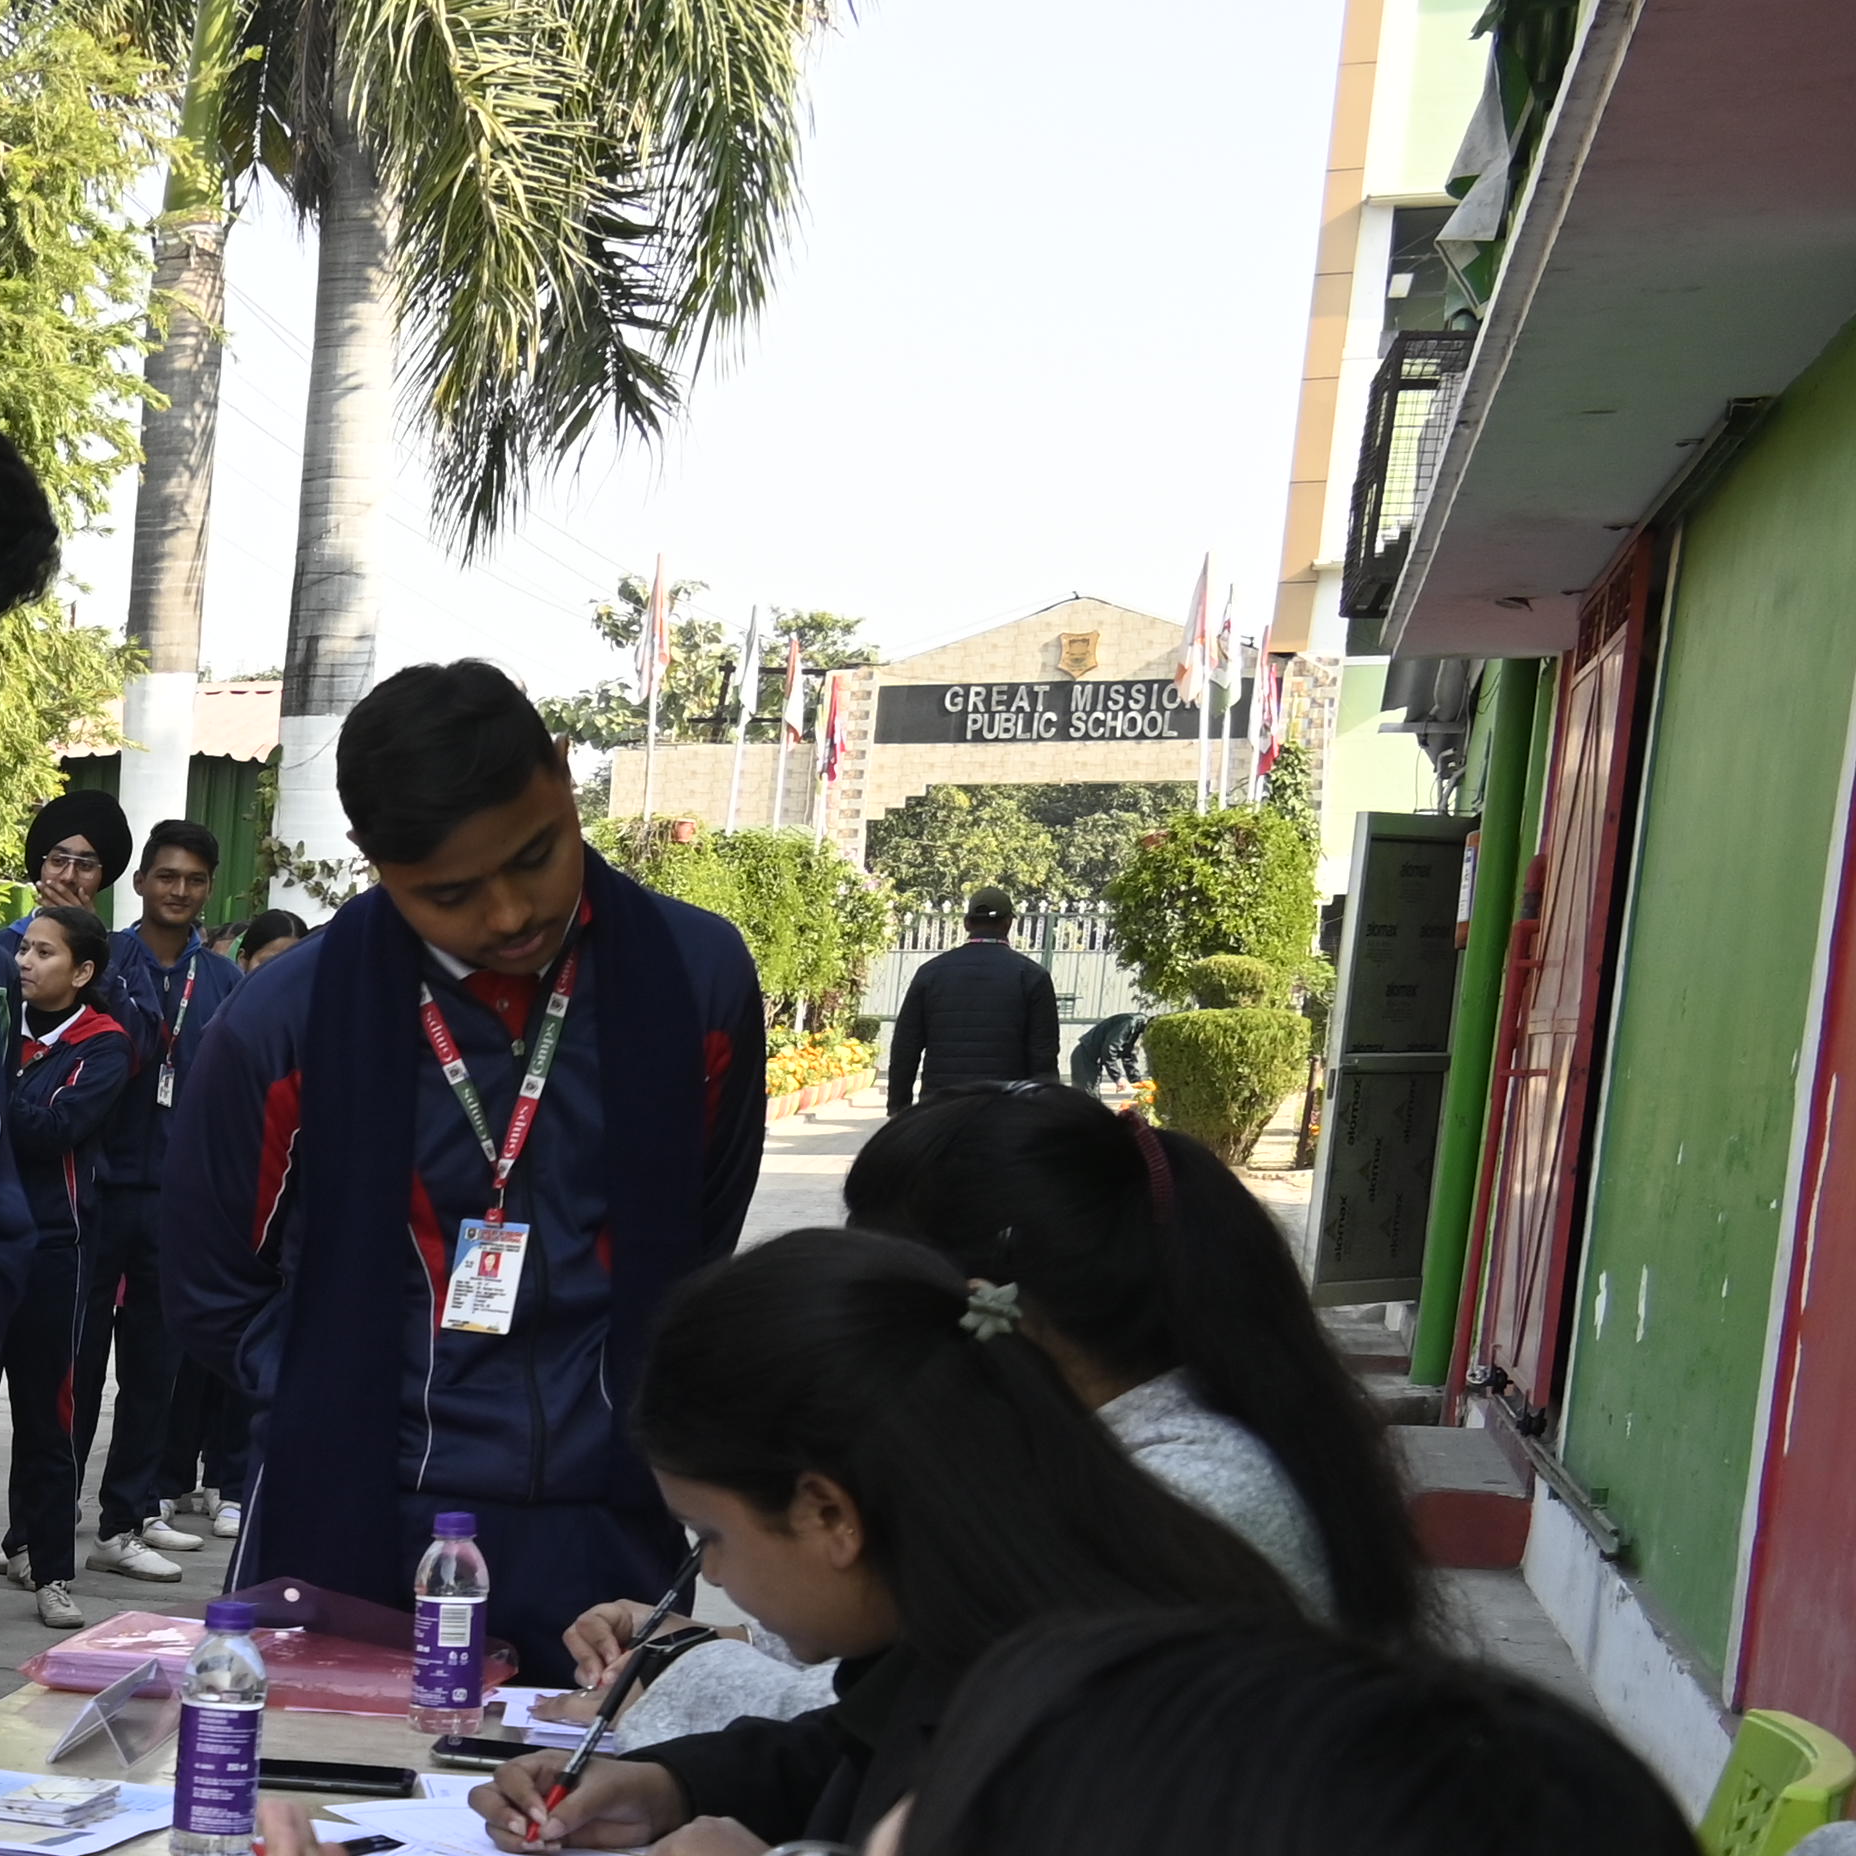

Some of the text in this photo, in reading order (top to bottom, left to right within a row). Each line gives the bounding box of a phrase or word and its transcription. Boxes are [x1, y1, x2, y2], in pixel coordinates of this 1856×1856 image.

[944, 684, 1050, 713] GREAT
[965, 710, 1179, 740] PUBLIC SCHOOL
[531, 1022, 556, 1075] Gmps
[504, 1104, 529, 1159] Gmps
[1347, 1079, 1362, 1146] alomax
[1368, 1136, 1383, 1203] alomax
[1334, 1195, 1349, 1262] alomax
